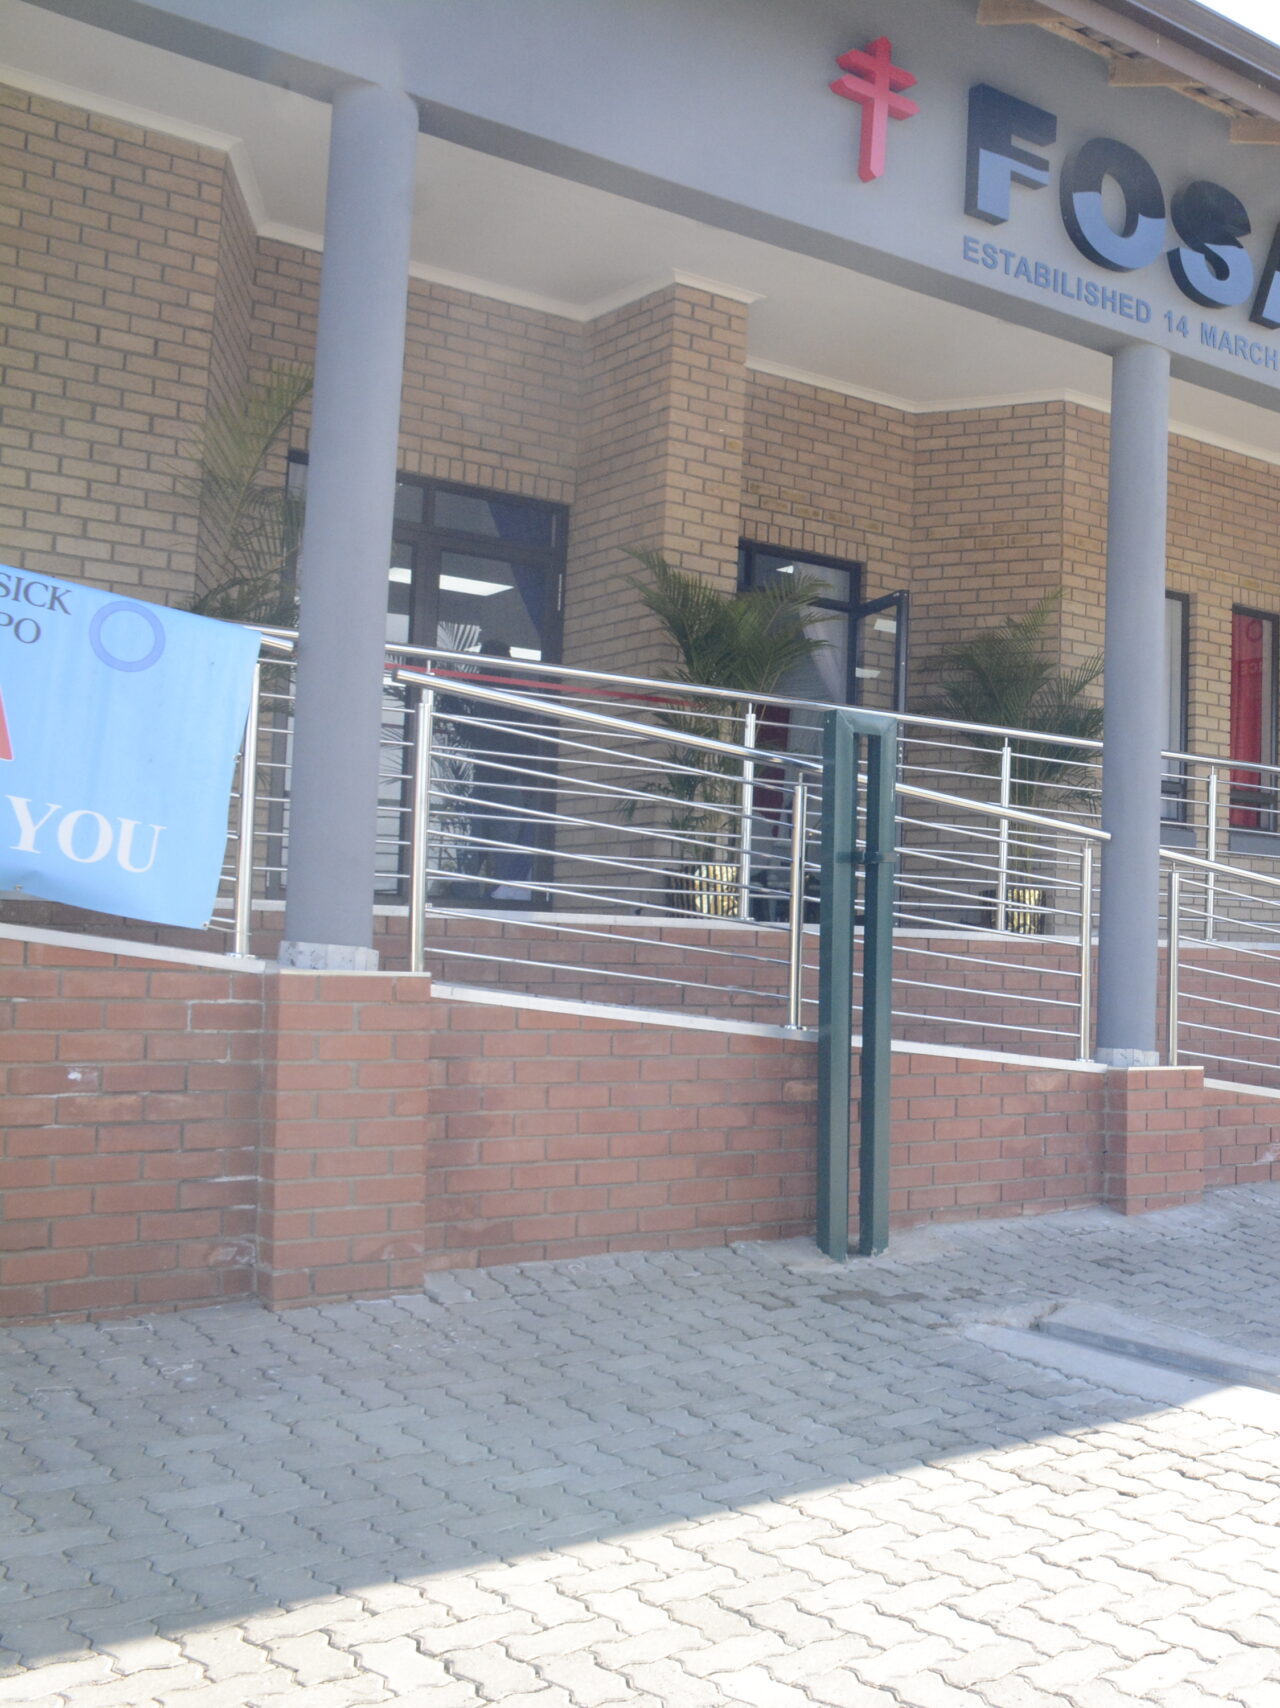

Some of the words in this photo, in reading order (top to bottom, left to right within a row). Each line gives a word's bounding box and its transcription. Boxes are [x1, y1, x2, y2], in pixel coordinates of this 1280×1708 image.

[963, 235, 1151, 324] ESTABILISHED
[1164, 310, 1189, 338] 14
[1201, 320, 1279, 371] MARCH
[5, 794, 167, 873] YOU
